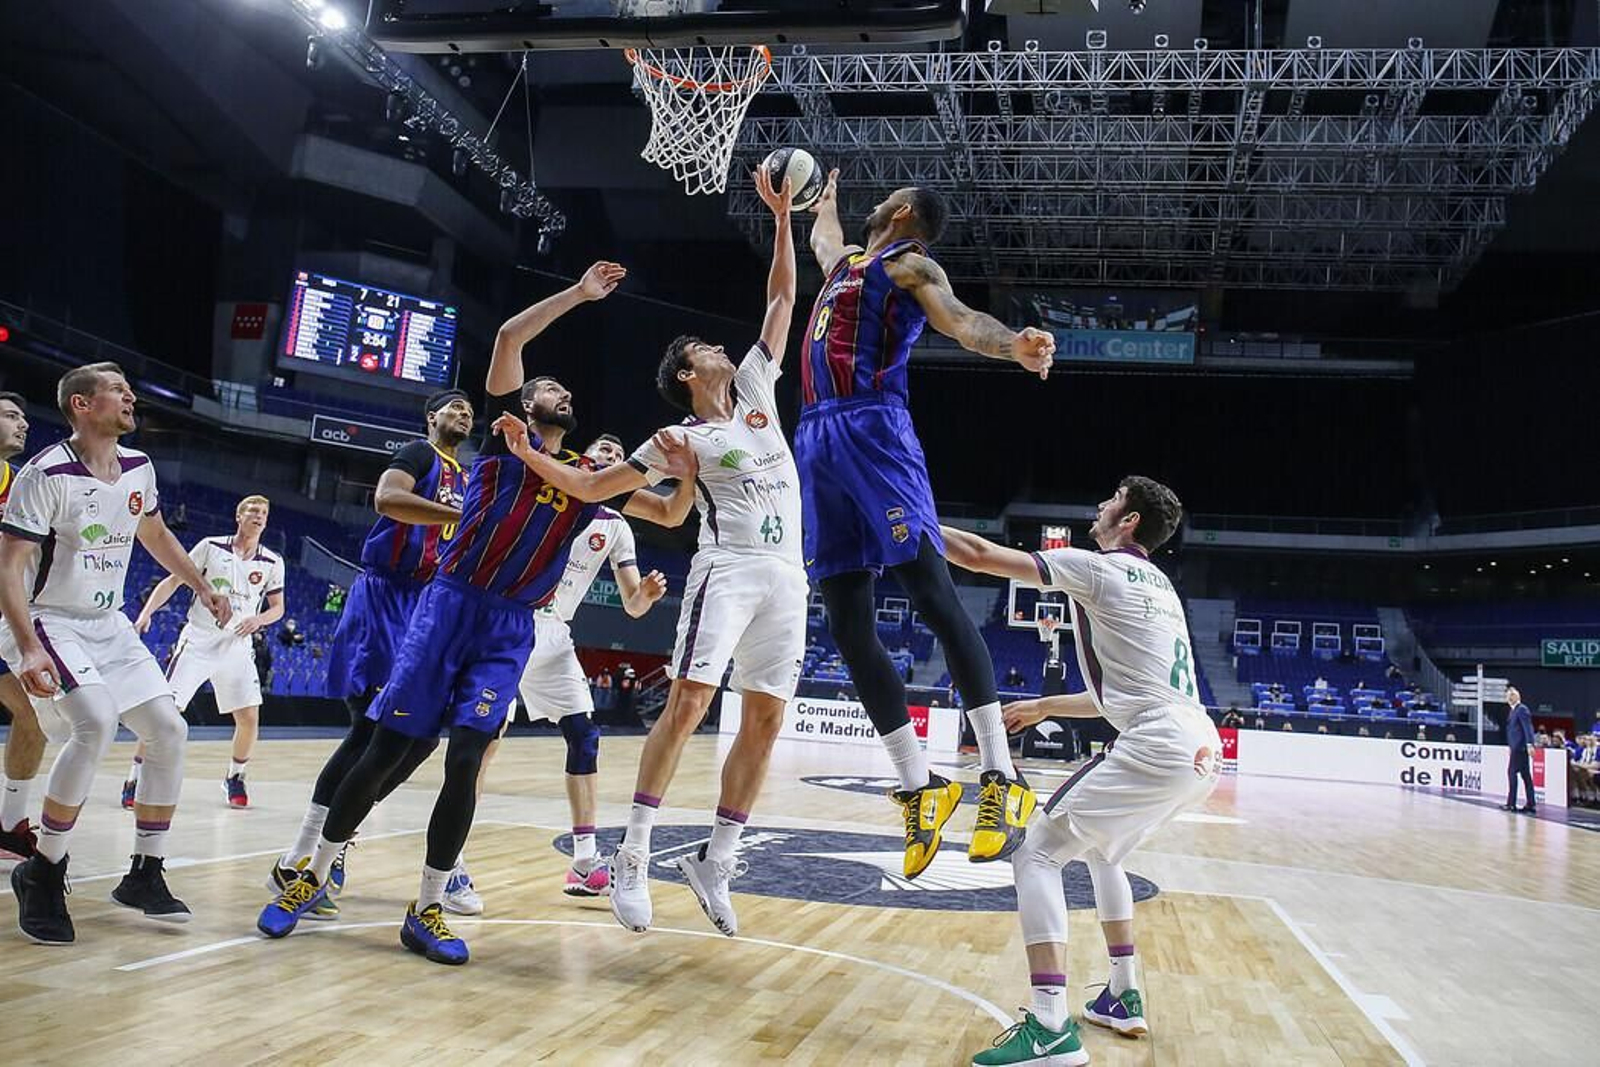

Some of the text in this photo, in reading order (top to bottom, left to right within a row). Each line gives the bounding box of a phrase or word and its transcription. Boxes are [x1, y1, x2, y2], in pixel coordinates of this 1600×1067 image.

[360, 288, 400, 309] 7 21
[322, 428, 350, 442] acb
[535, 483, 569, 513] 33
[760, 514, 783, 545] 43
[1546, 642, 1600, 655] SALID
[1169, 637, 1194, 697] 8
[1564, 655, 1594, 666] EXIT
[797, 702, 868, 719] Comunida
[795, 719, 875, 738] de Madrid
[1400, 766, 1431, 785] de
